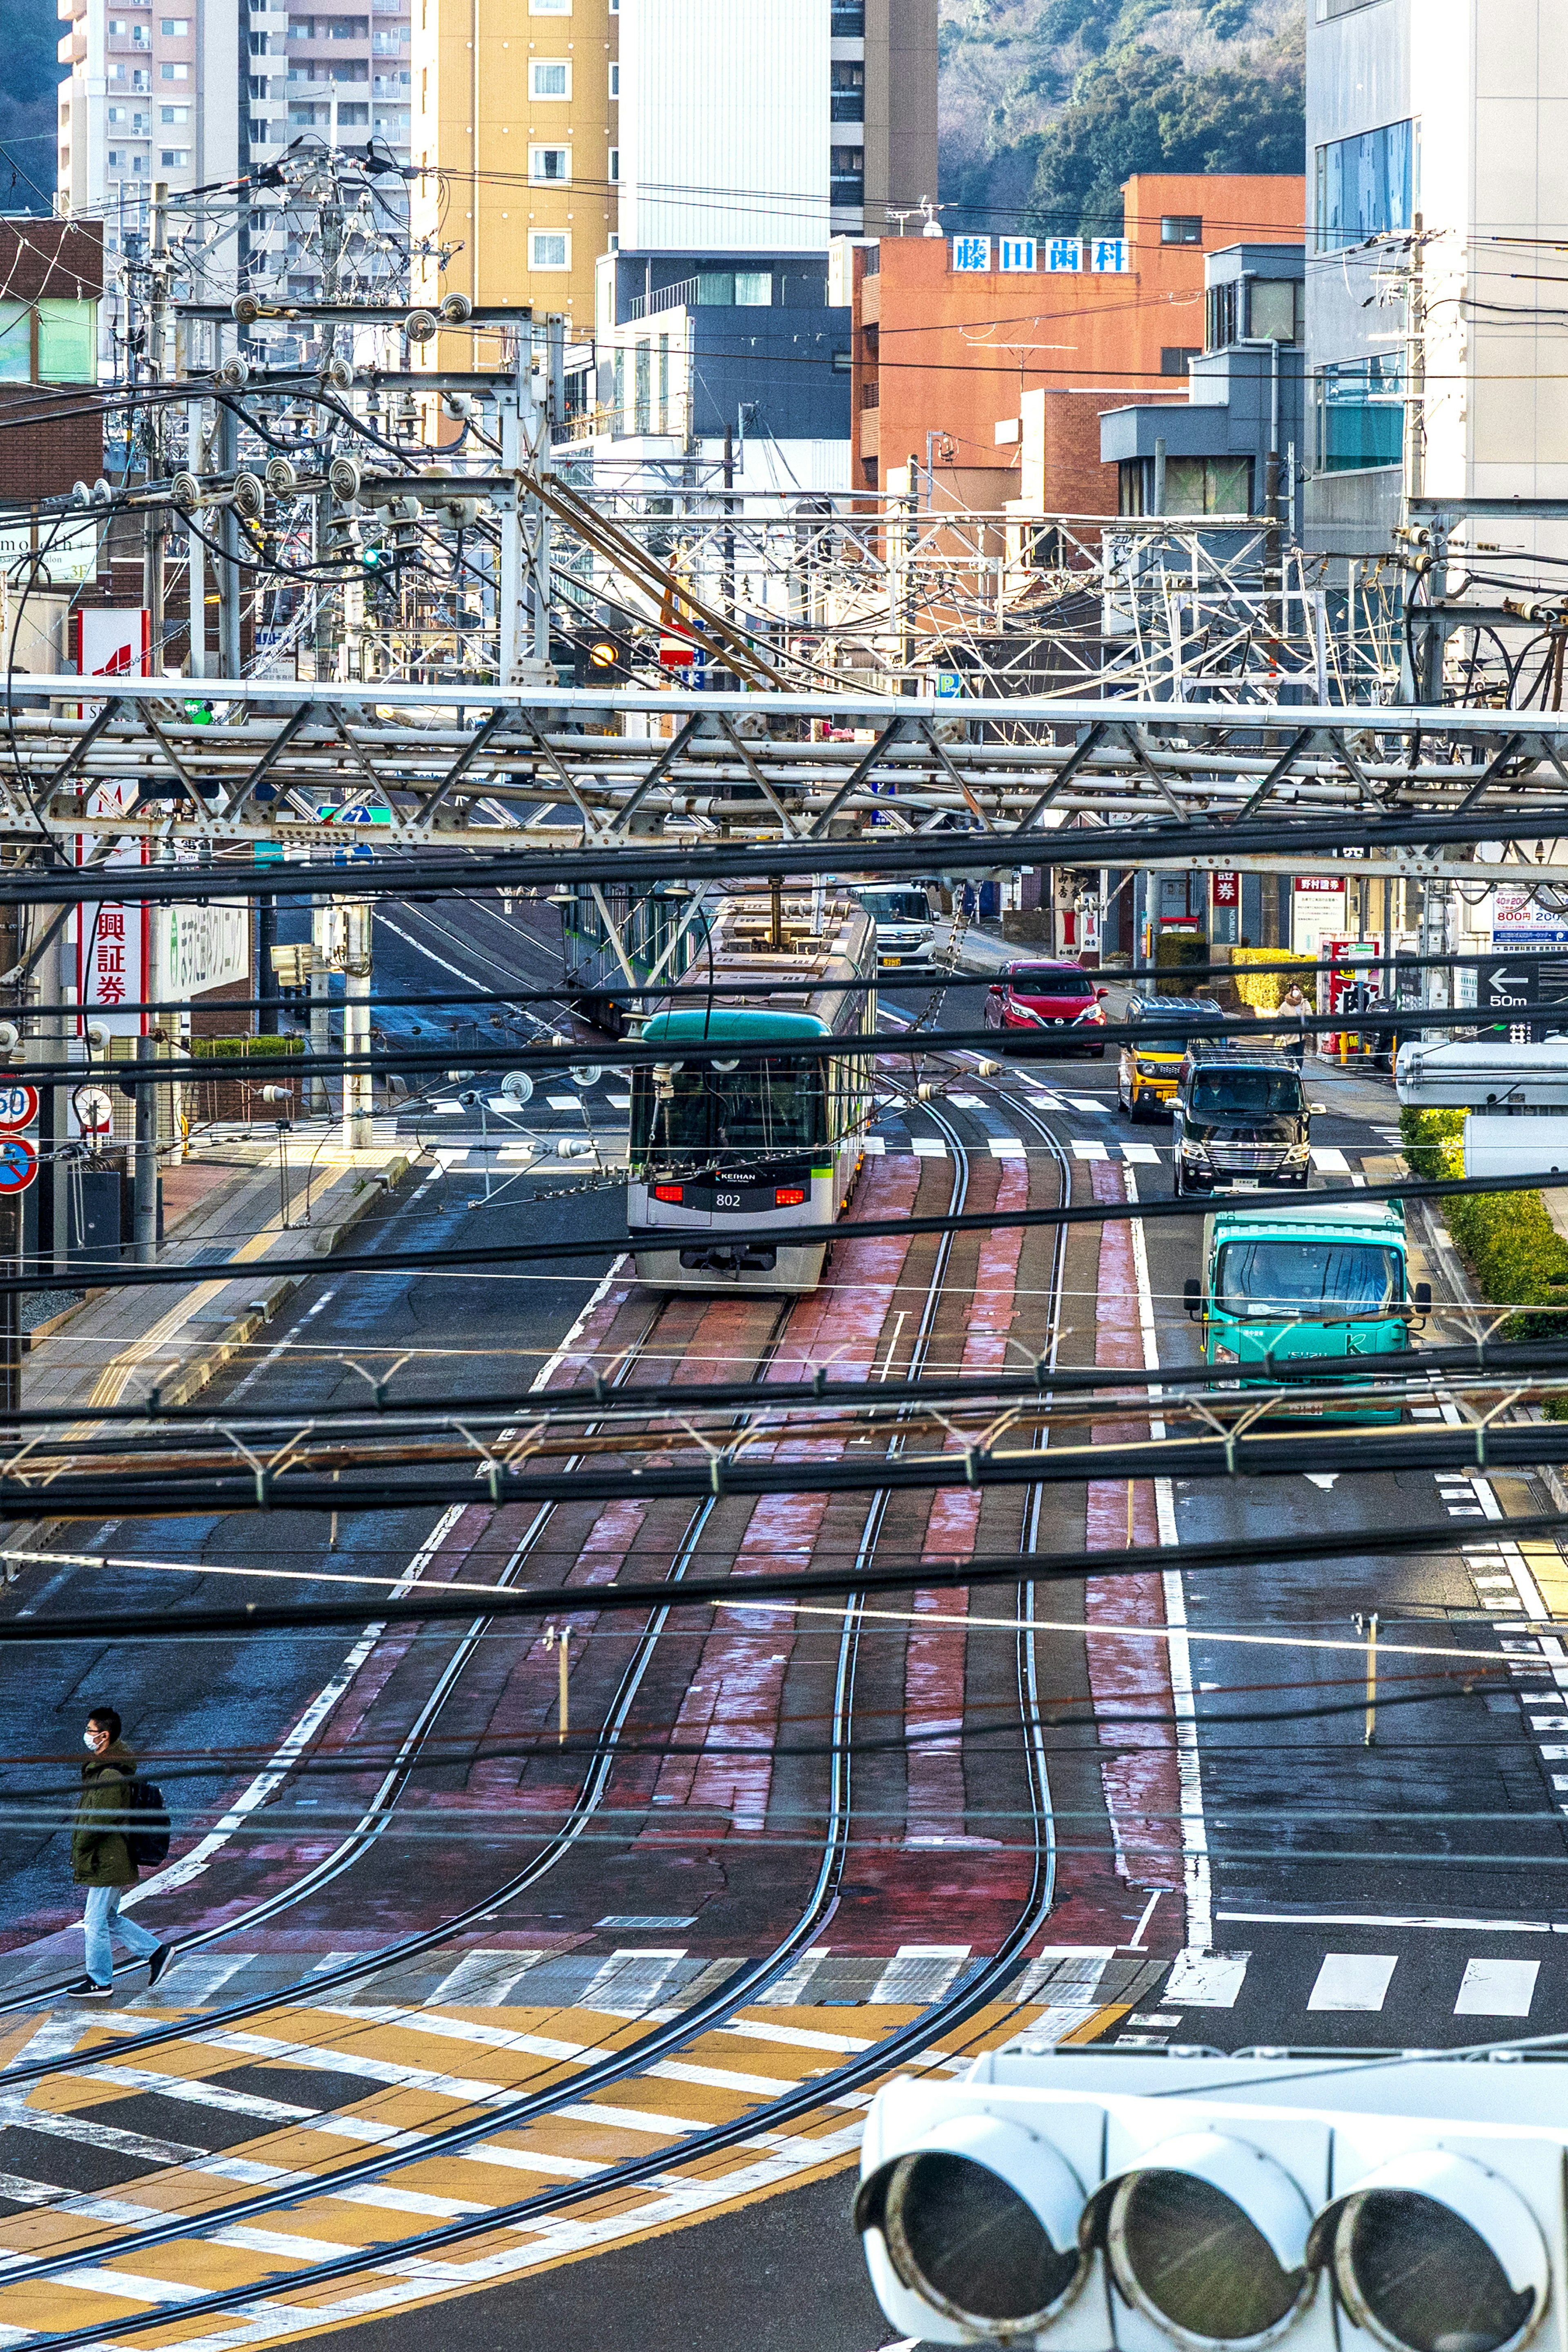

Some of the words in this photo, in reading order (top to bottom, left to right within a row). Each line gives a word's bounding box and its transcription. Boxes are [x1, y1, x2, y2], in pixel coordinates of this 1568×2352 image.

[957, 238, 1125, 271] 藤田歯科
[40, 555, 62, 563] alon
[941, 675, 954, 693] P
[1301, 879, 1339, 890] 野村證券
[1497, 912, 1530, 921] 800円
[97, 900, 126, 1005] 興証券
[1490, 995, 1527, 1007] 50m
[716, 1194, 741, 1207] 802
